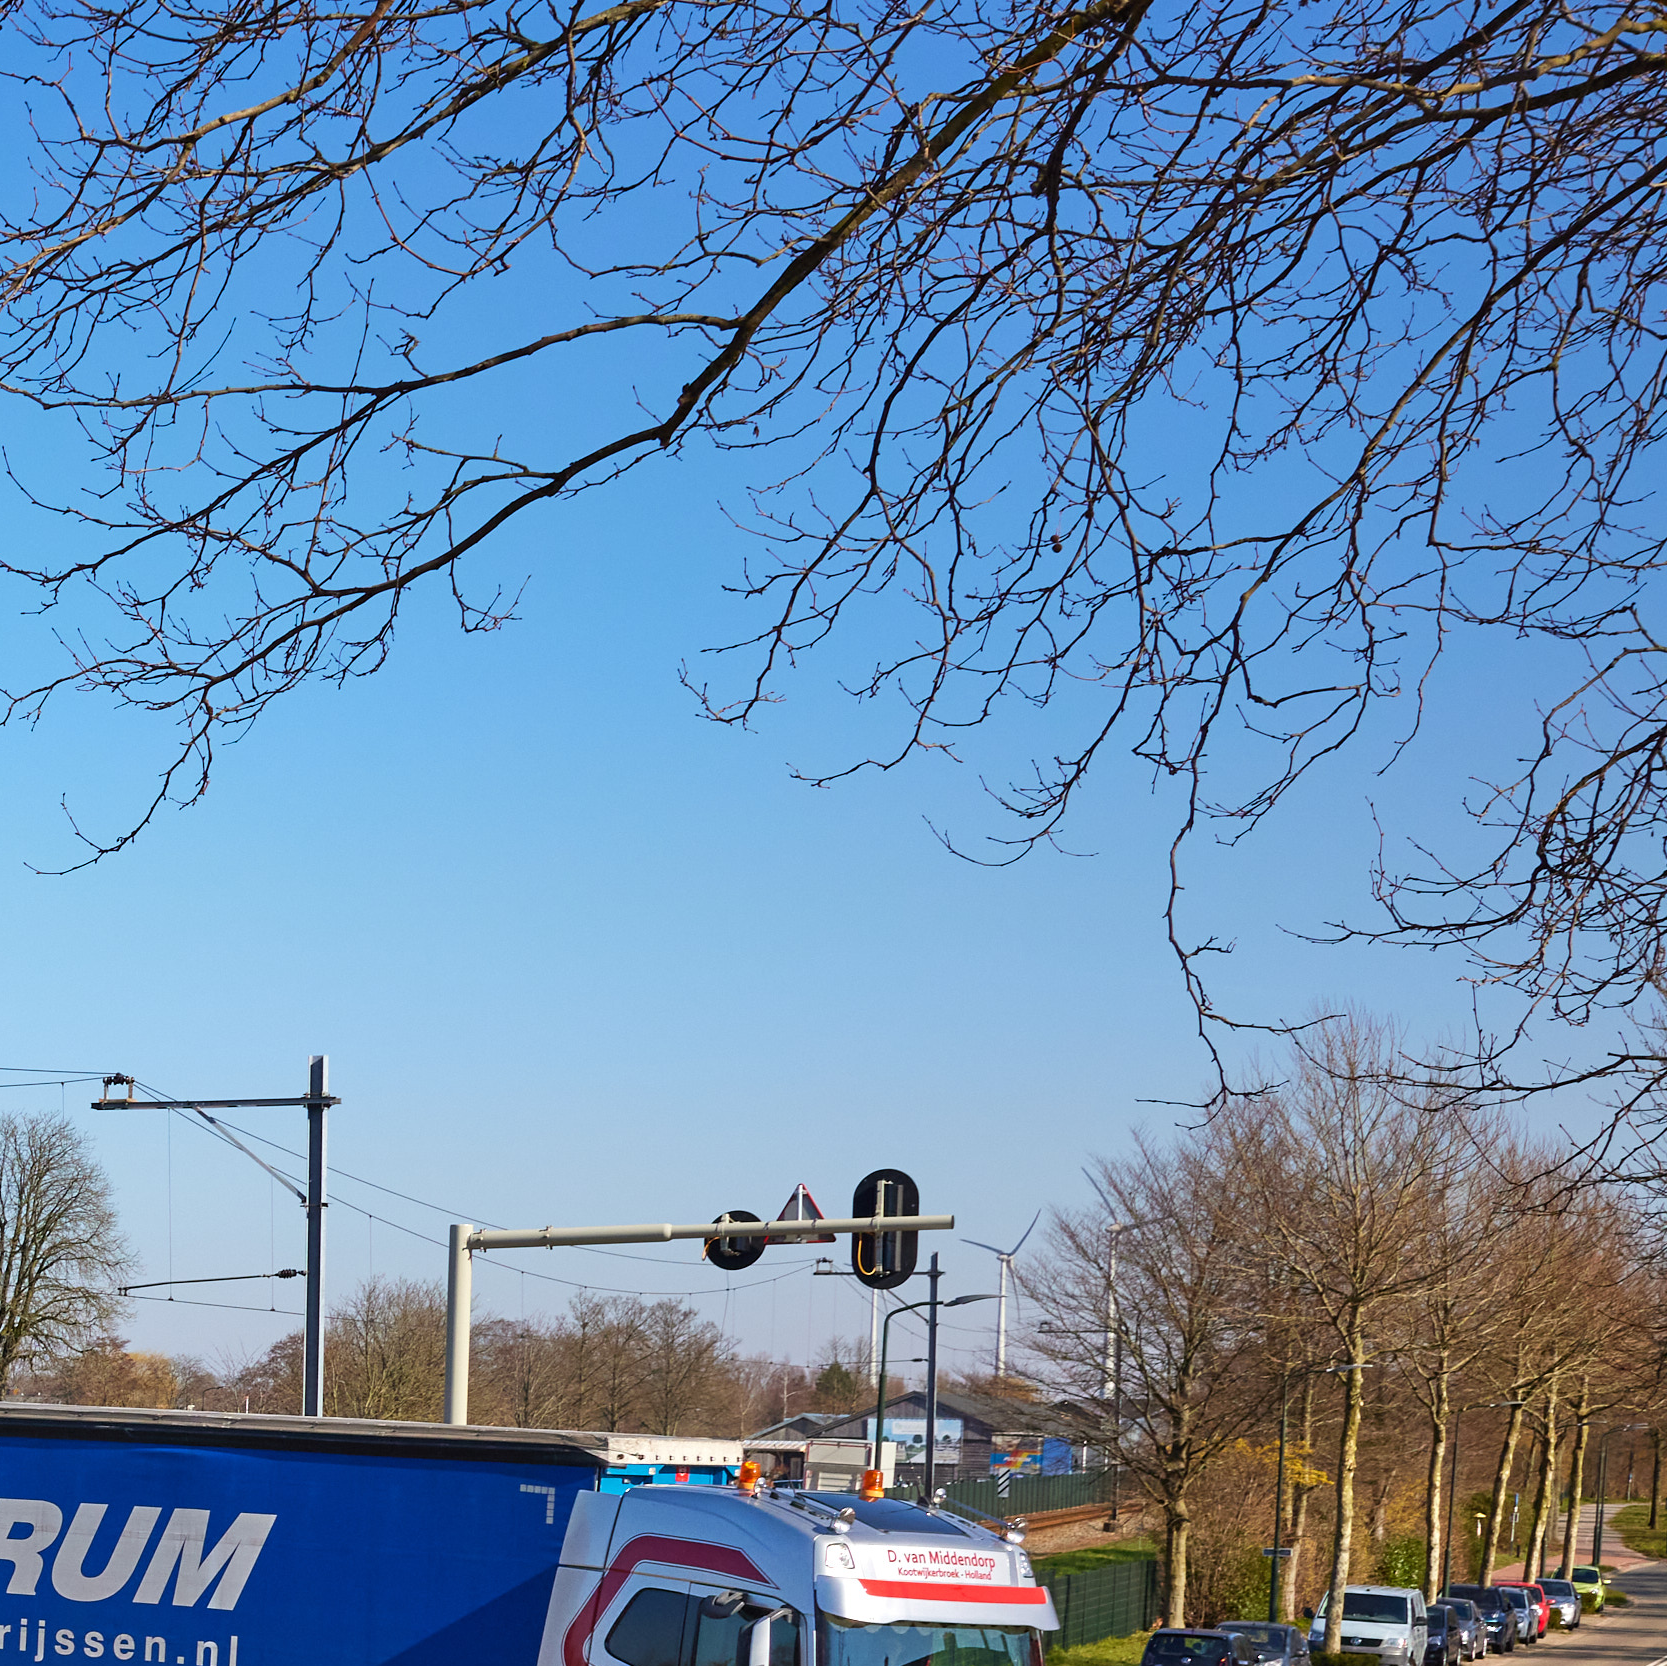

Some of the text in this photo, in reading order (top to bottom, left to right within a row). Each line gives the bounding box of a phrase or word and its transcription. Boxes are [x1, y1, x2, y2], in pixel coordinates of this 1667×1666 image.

[887, 1549, 995, 1571] D. van Middendorp
[898, 1567, 959, 1579] Kootwijkerbroek
[965, 1570, 992, 1580] Holland
